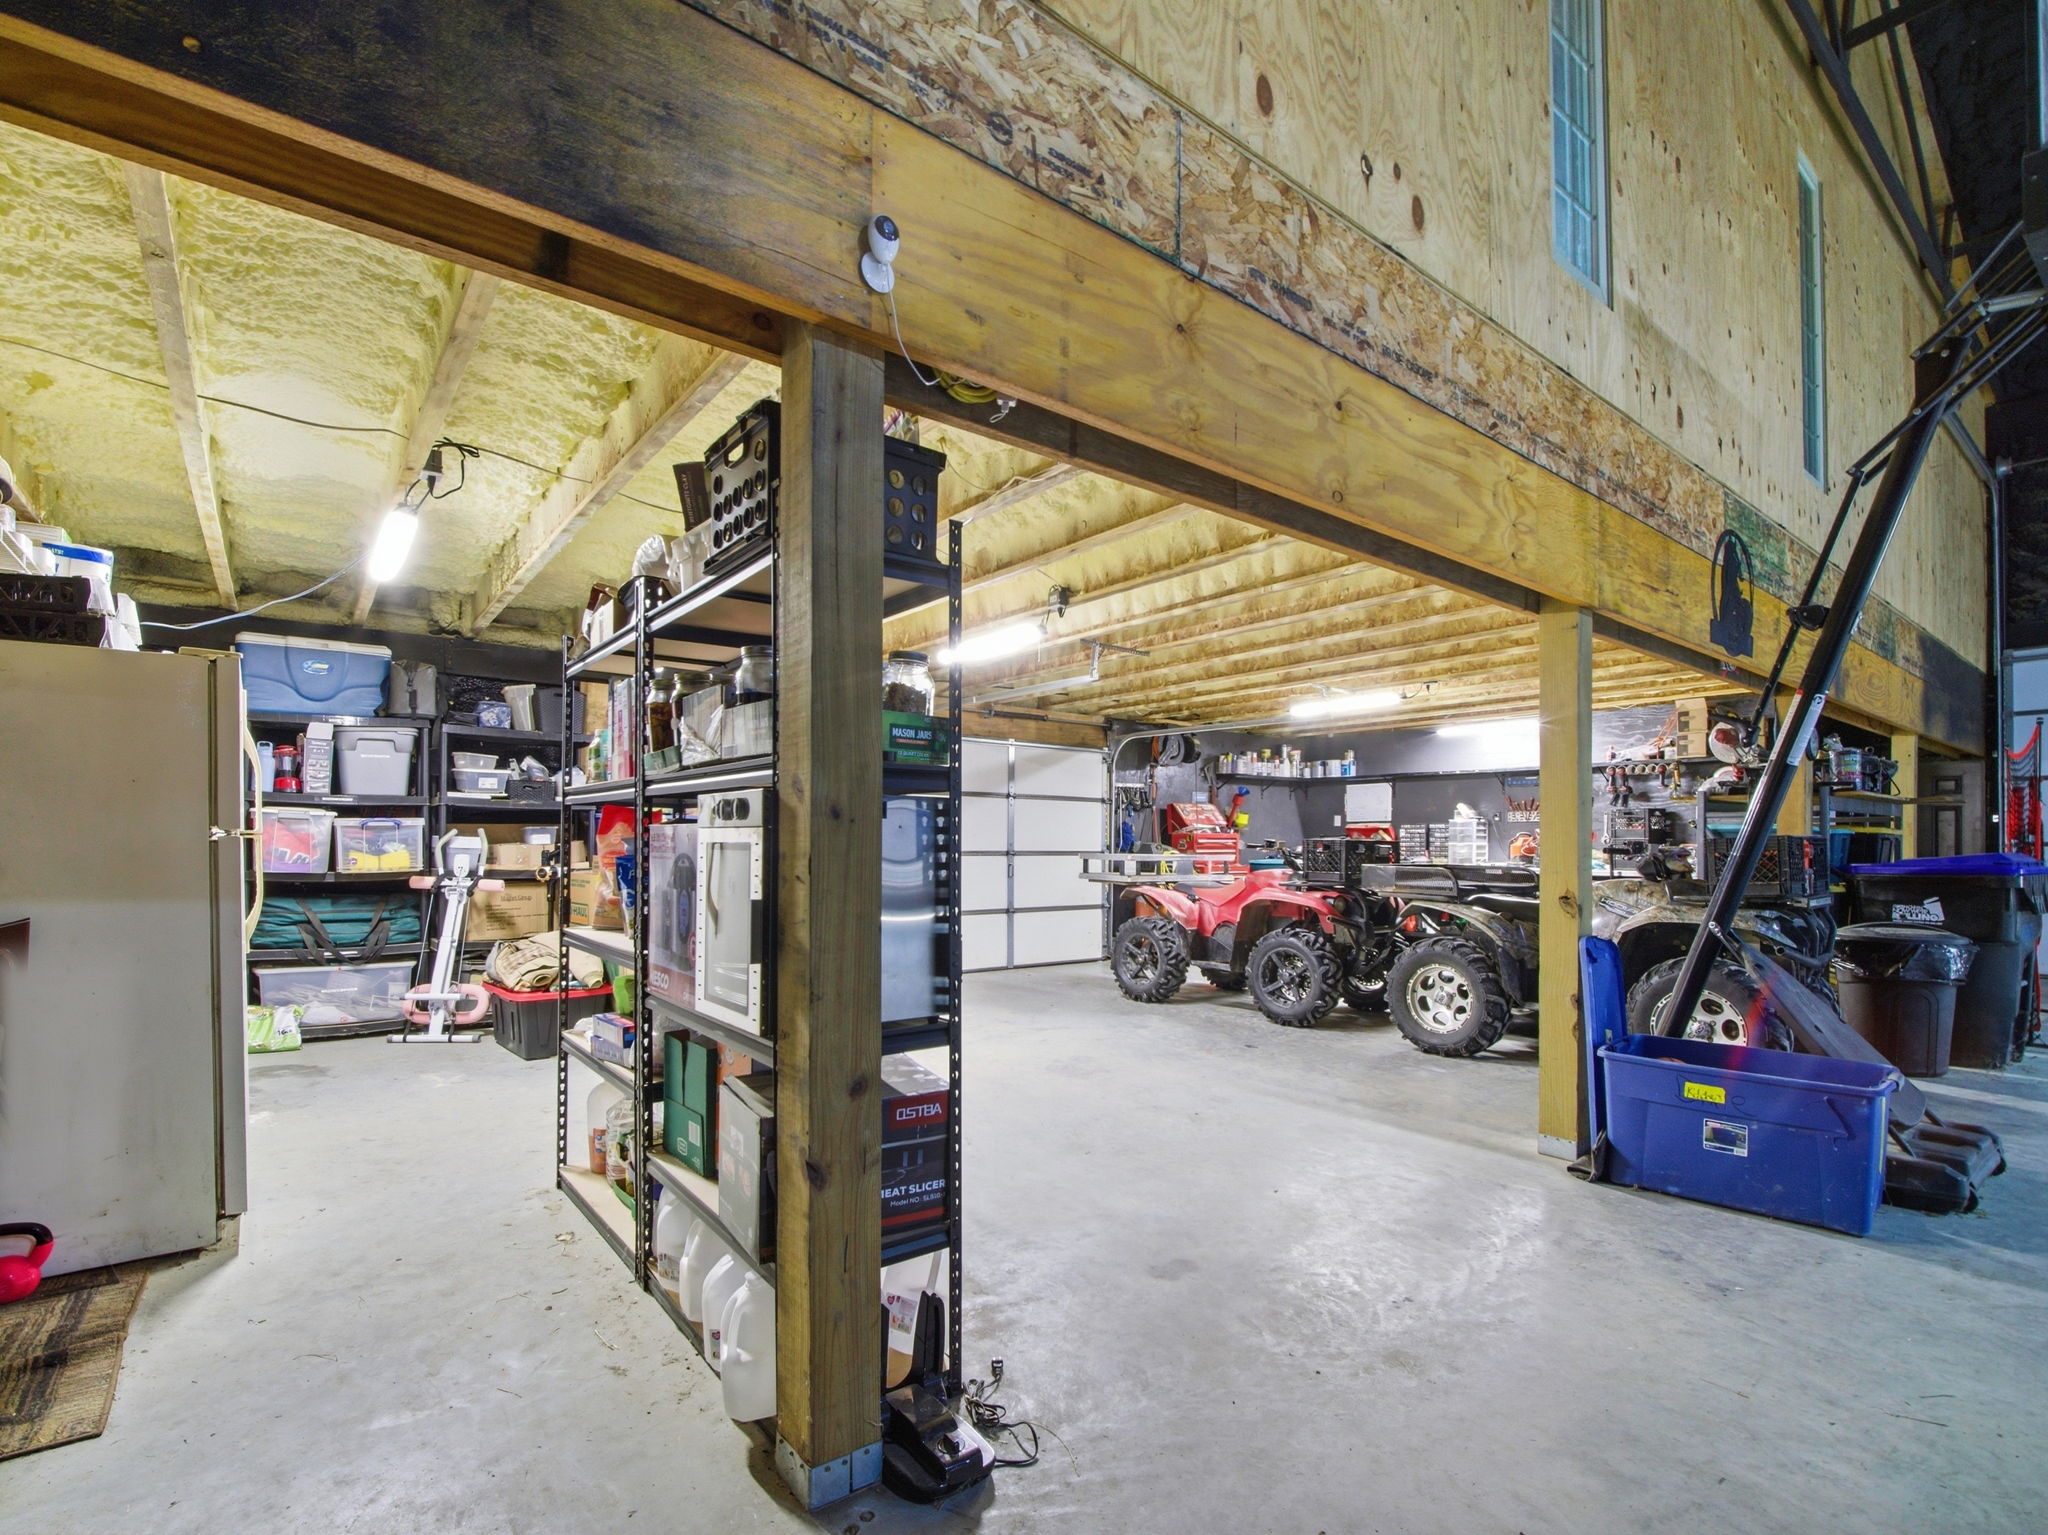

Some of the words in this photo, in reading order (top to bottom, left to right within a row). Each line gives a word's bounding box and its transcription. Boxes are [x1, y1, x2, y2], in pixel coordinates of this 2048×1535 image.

[892, 727, 915, 738] MASON
[917, 729, 932, 740] JARS
[896, 1103, 942, 1121] OSTBA
[908, 1178, 945, 1195] SLICER
[890, 1197, 909, 1208] Model
